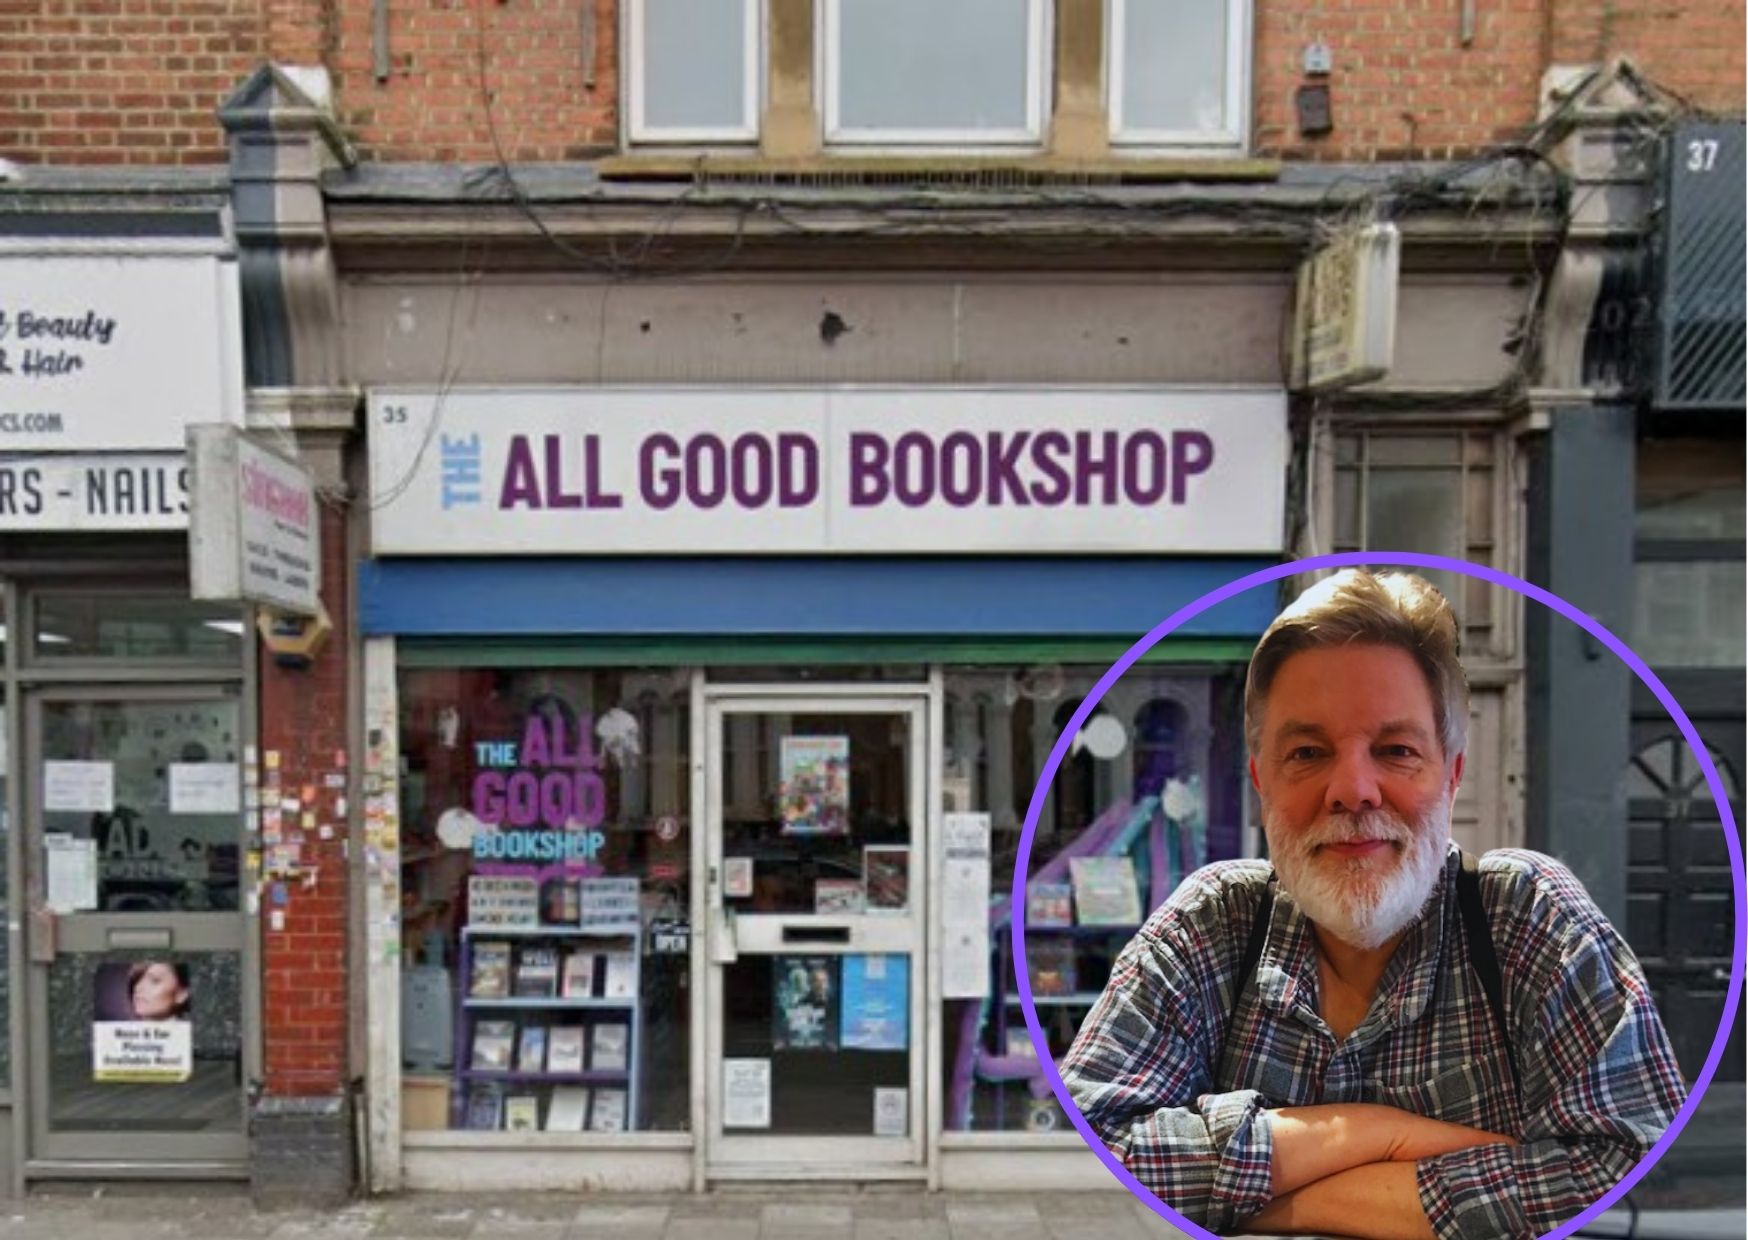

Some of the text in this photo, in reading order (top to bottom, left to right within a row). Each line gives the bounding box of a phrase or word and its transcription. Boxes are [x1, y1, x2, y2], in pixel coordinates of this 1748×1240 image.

[1687, 140, 1718, 172] 37
[17, 310, 117, 345] Beauty
[22, 349, 84, 378] Hair
[383, 406, 408, 424] 35
[440, 429, 1214, 511] THE ALL GOOD BOOKSHOP
[475, 712, 604, 768] THE ALL
[473, 771, 605, 827] GOOD
[473, 830, 605, 860] BOOKSHOP
